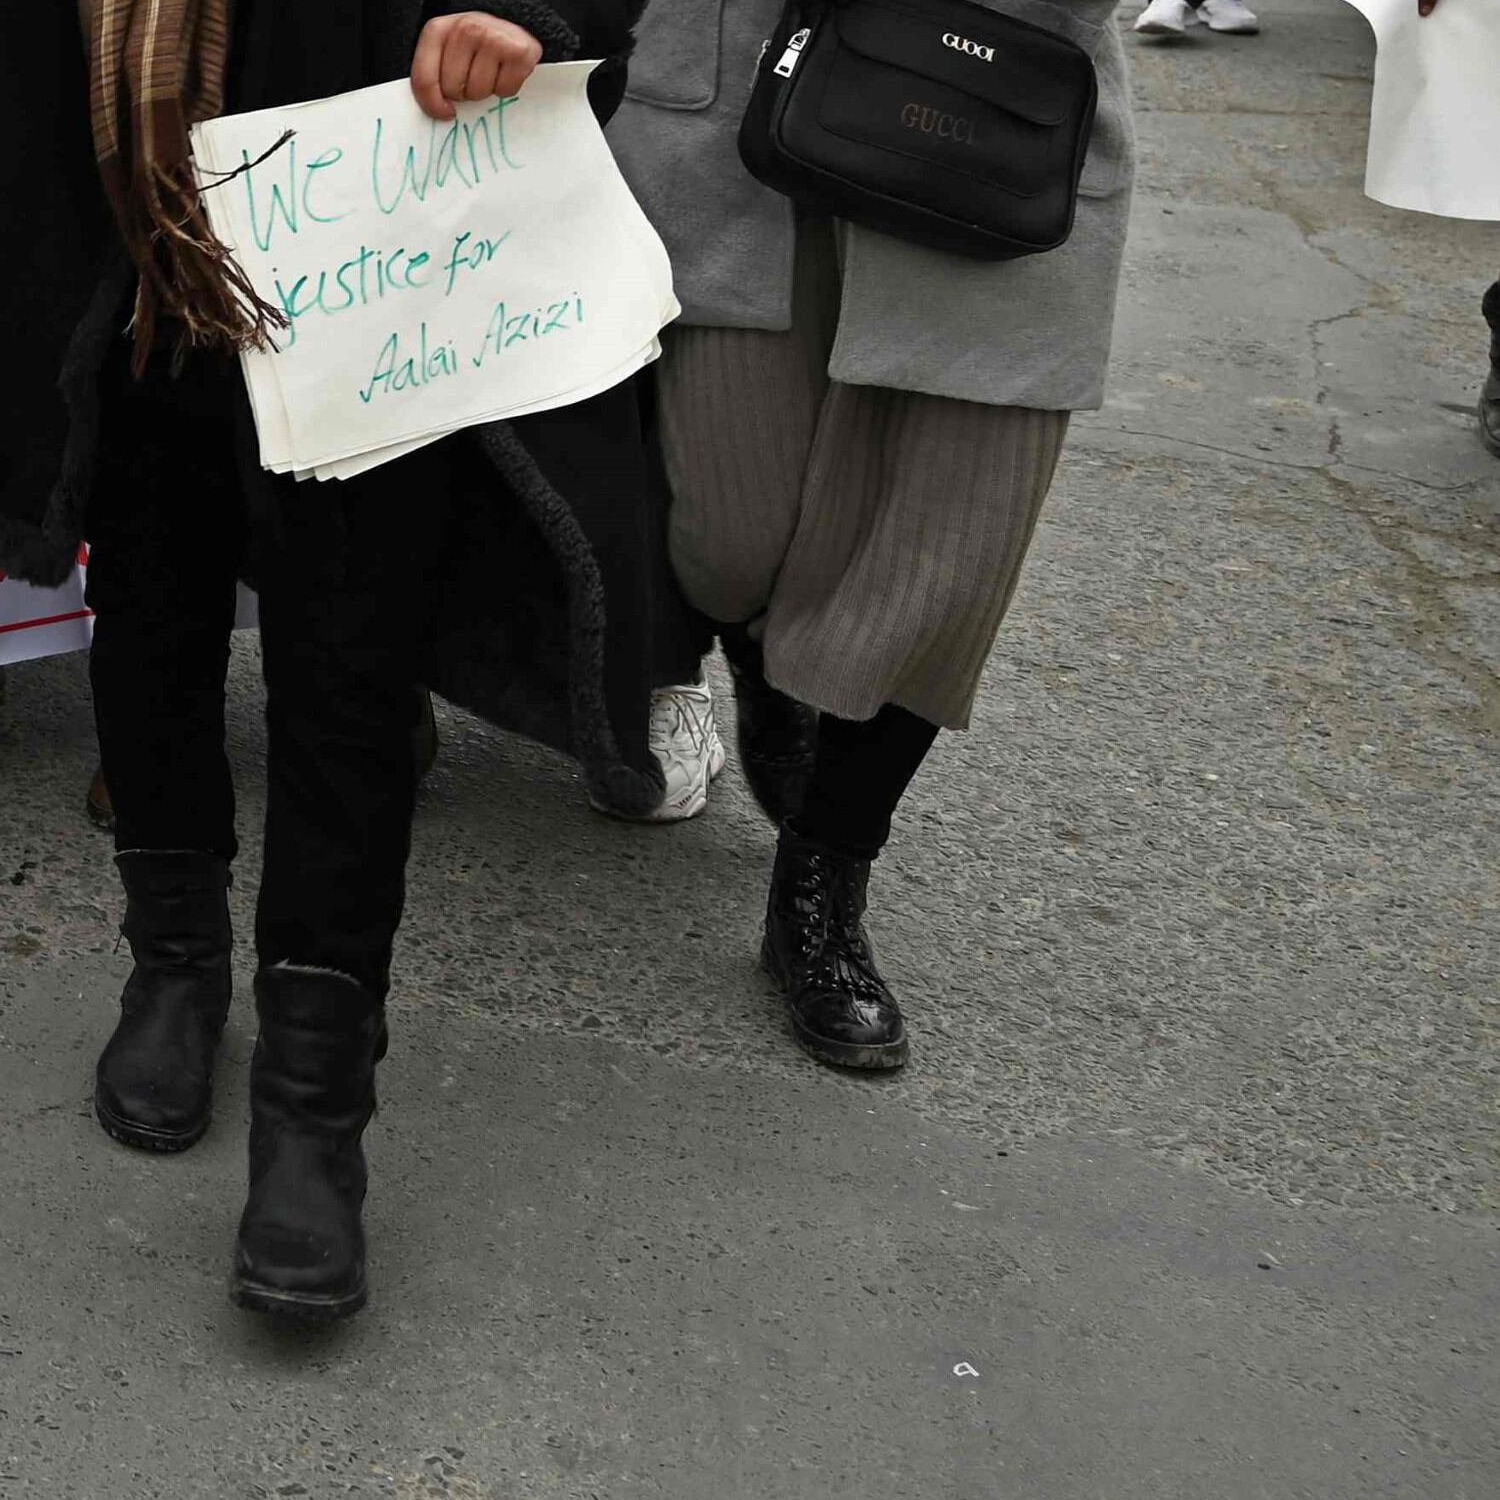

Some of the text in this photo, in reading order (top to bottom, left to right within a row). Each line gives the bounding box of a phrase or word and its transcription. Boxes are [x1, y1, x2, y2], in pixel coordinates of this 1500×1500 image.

[243, 96, 526, 251] We Want
[444, 230, 511, 296] for
[472, 291, 584, 366] Azizi
